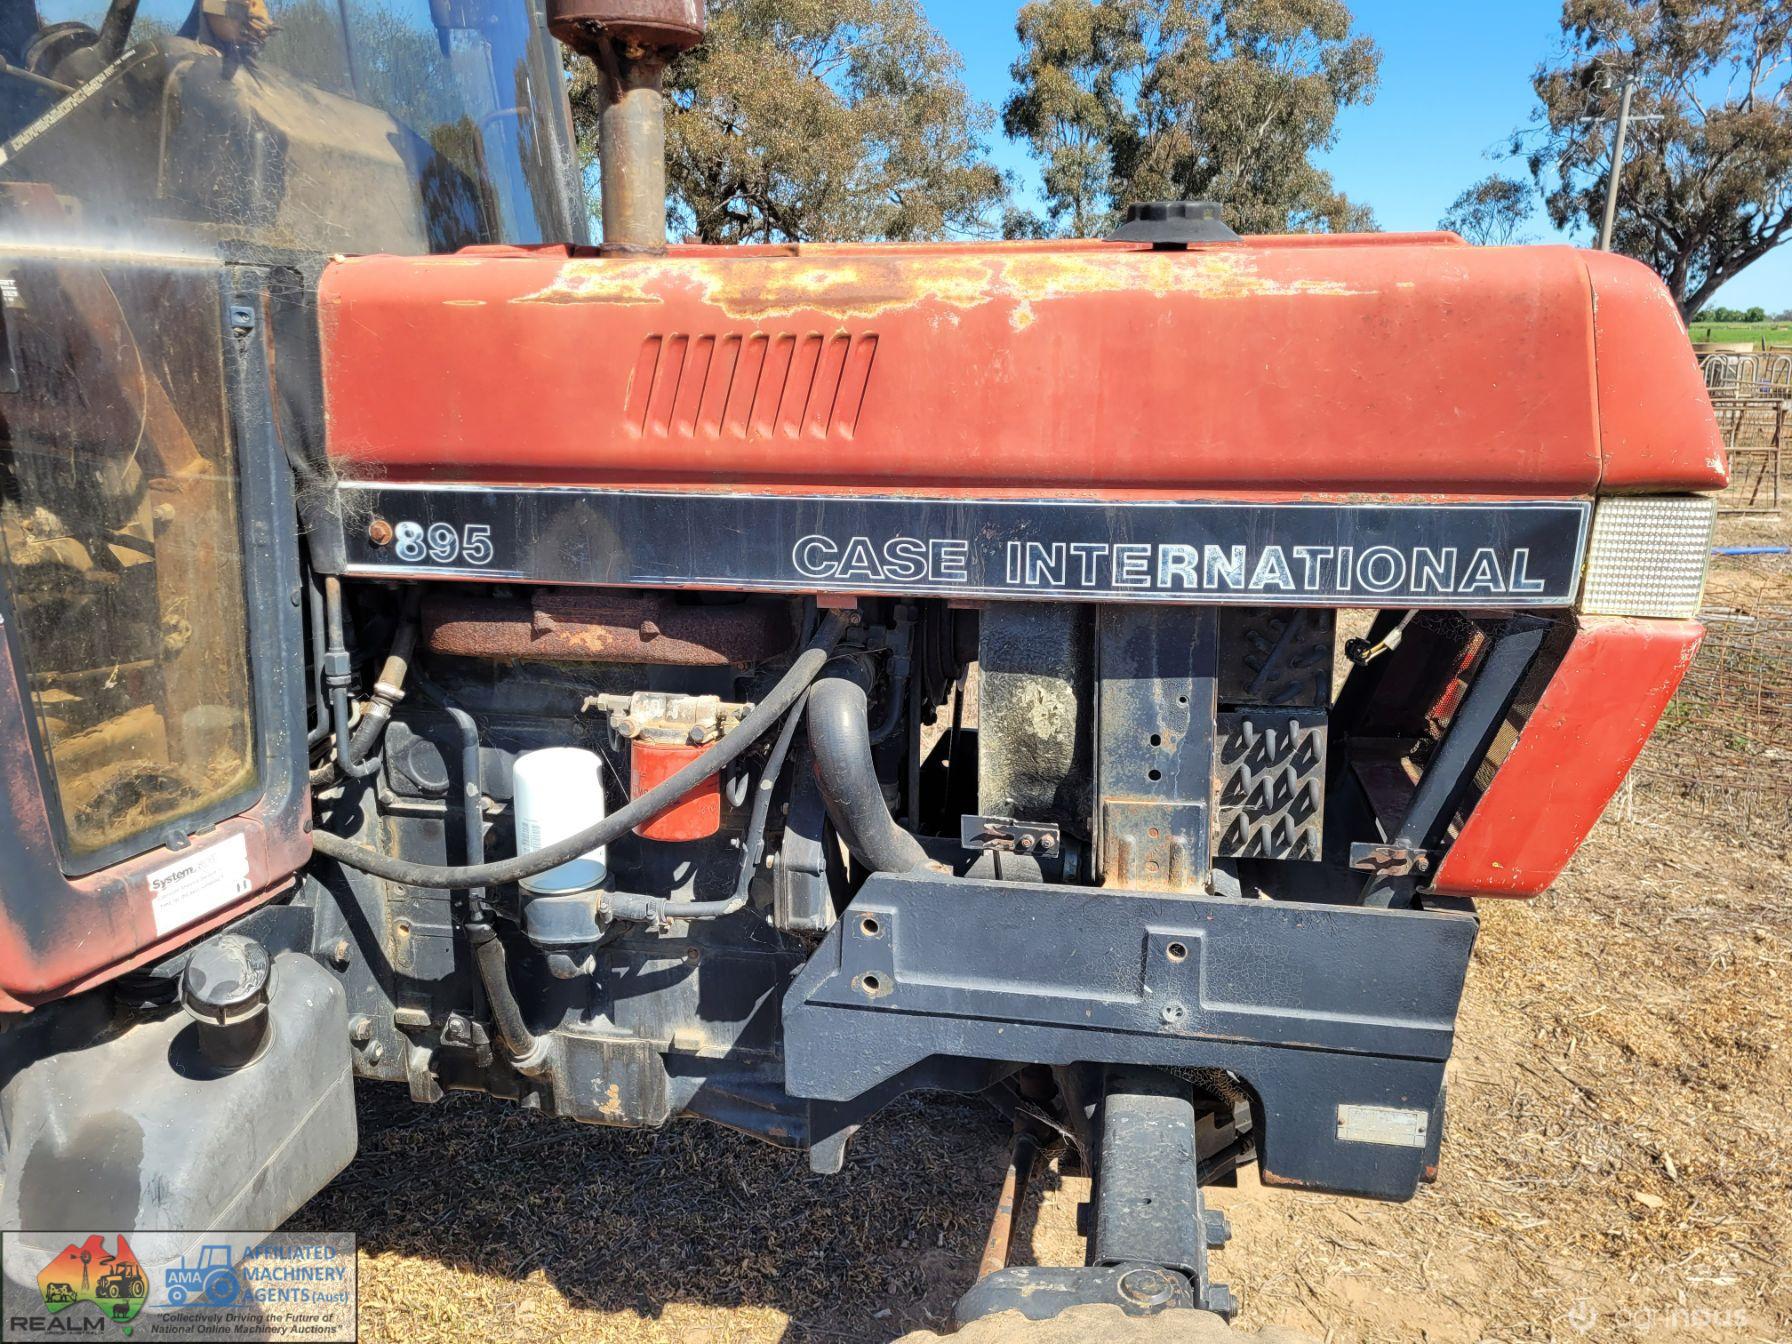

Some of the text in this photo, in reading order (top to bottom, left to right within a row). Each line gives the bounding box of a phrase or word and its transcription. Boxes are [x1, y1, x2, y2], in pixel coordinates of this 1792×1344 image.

[394, 521, 494, 565] 895
[792, 534, 1545, 594] CASE INTERNATIONAL
